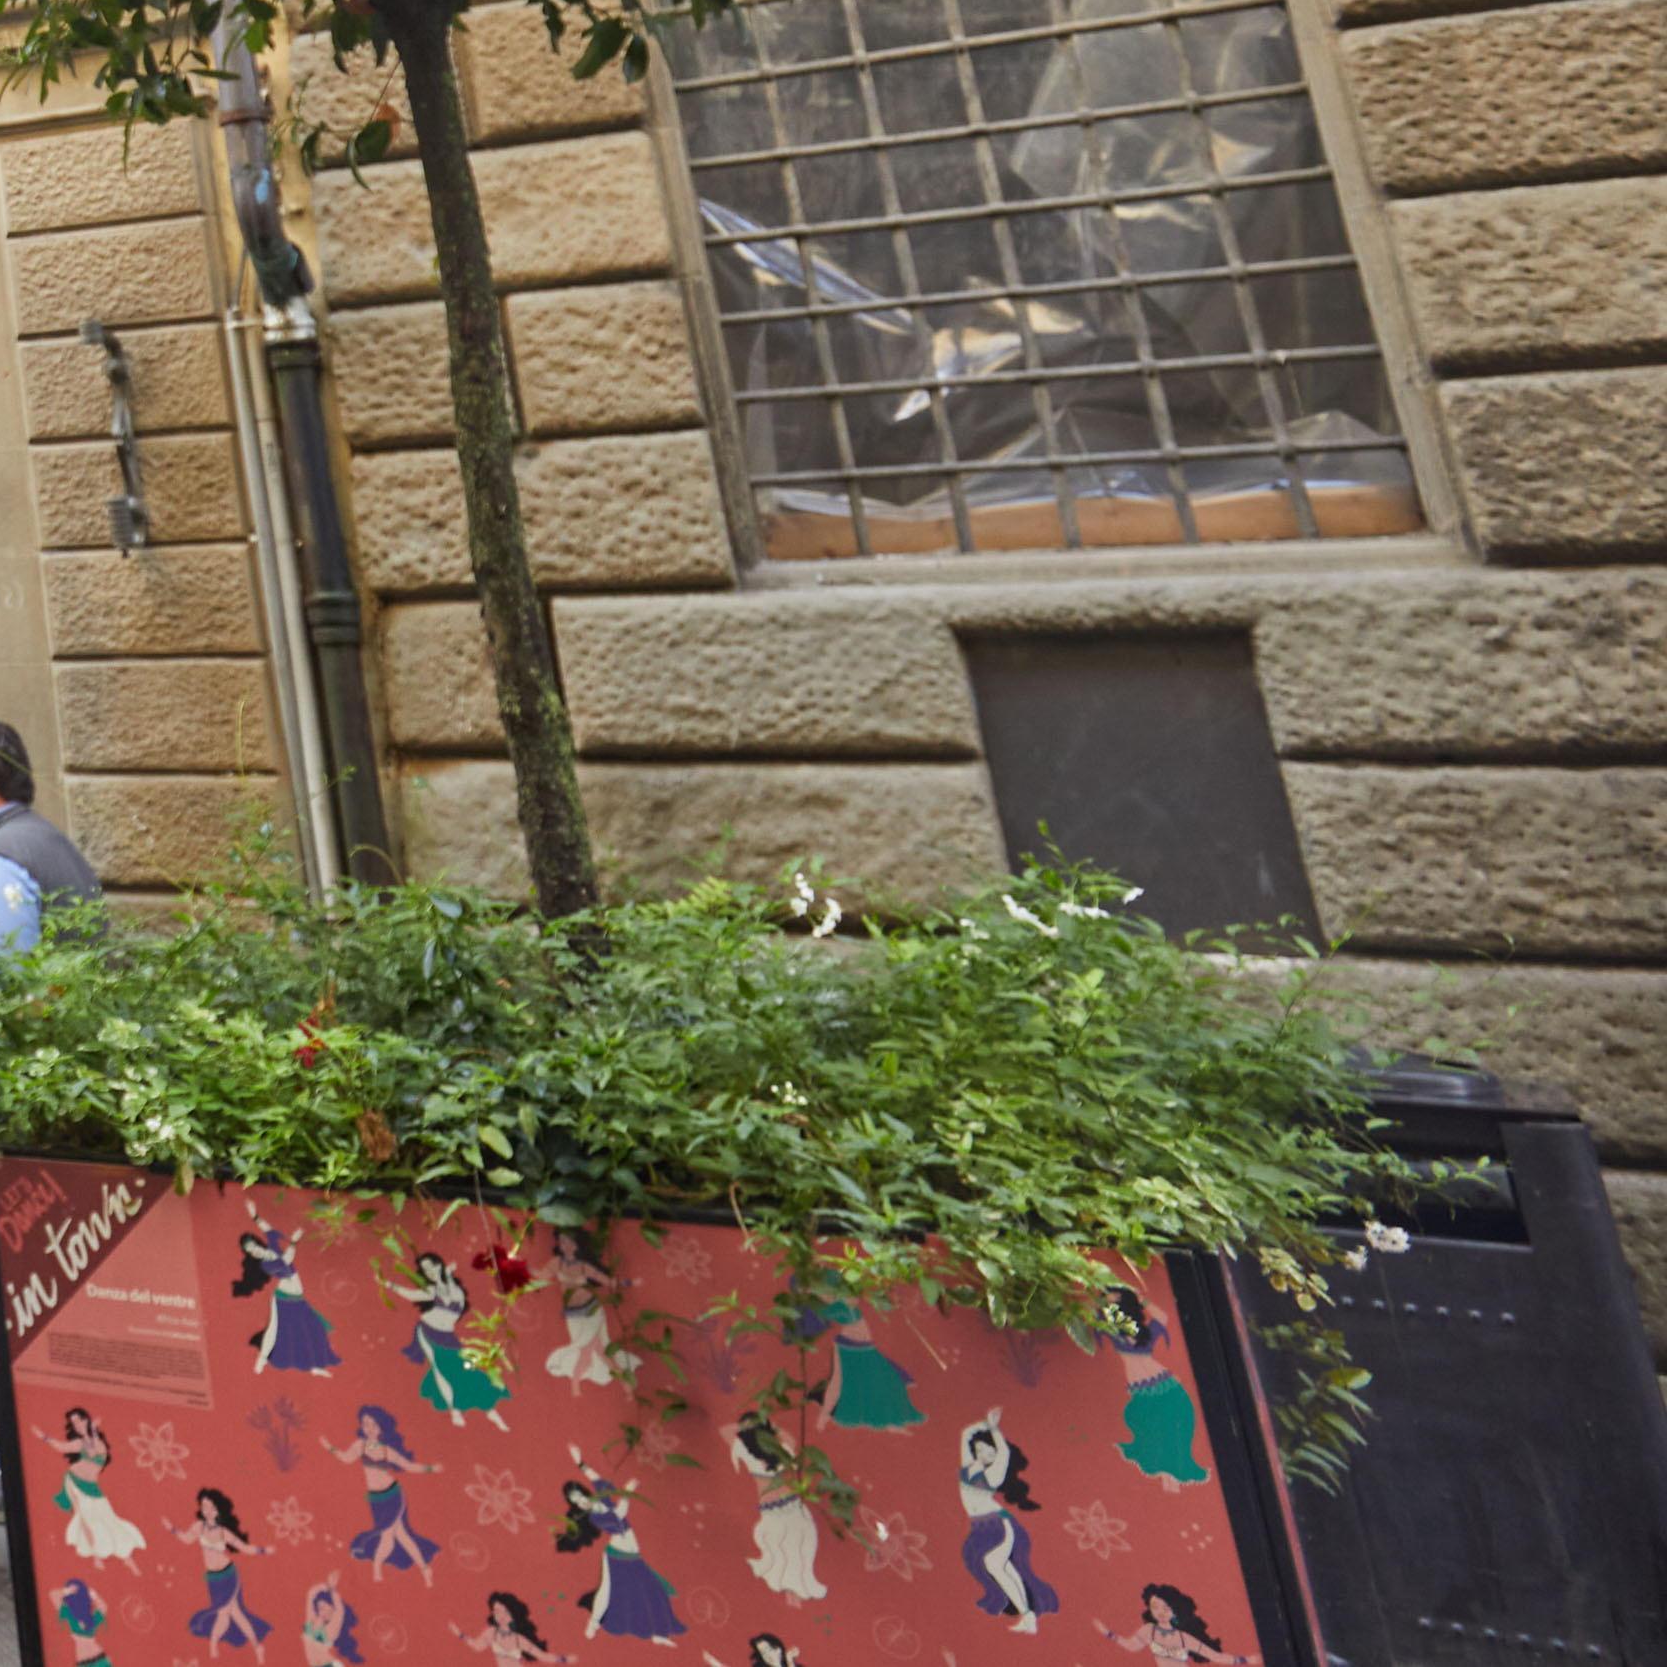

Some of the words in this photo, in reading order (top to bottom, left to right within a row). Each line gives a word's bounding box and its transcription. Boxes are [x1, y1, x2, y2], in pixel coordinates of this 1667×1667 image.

[6, 1272, 59, 1337] in
[44, 1183, 145, 1282] town
[86, 1283, 128, 1302] Danza
[129, 1289, 151, 1305] del
[152, 1294, 197, 1311] ventre
